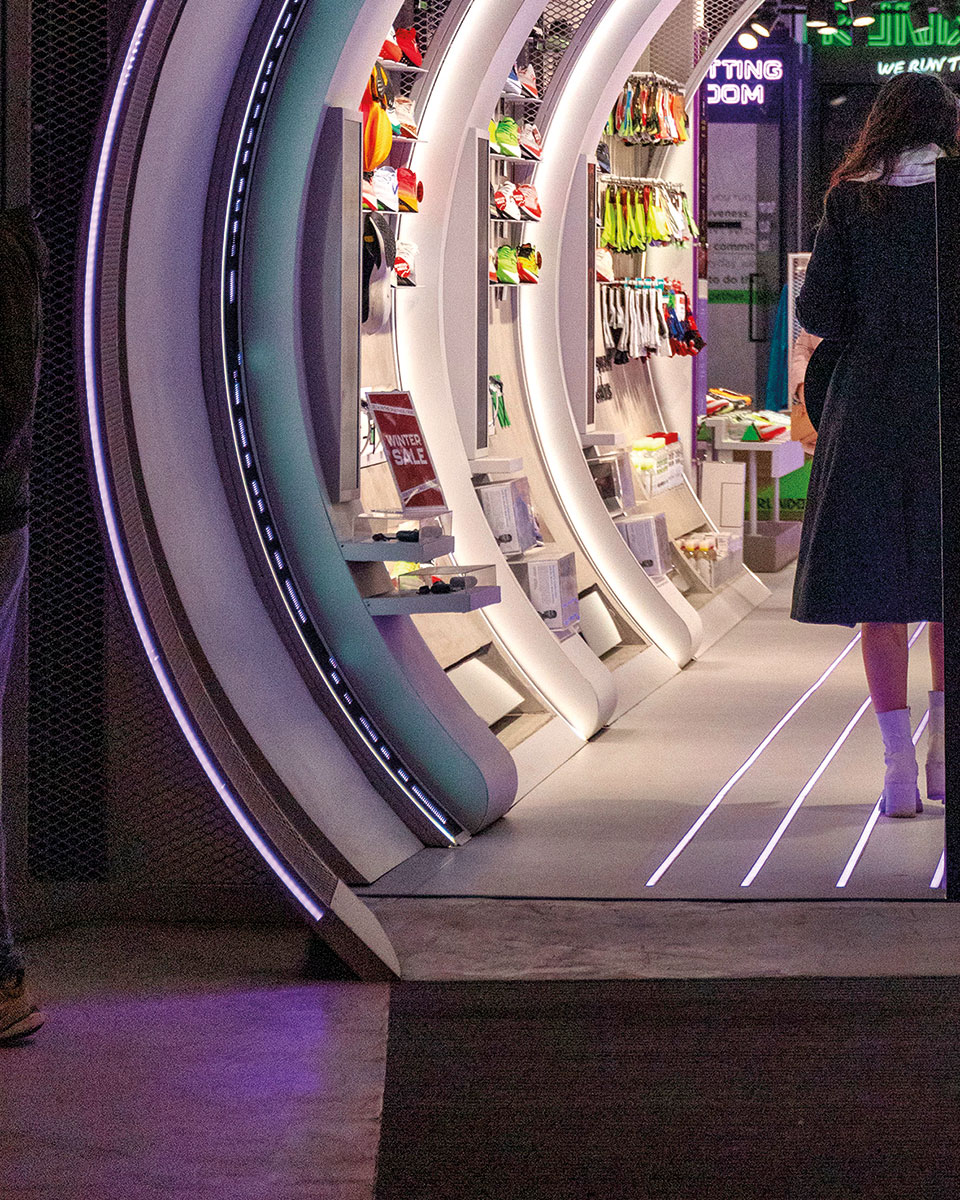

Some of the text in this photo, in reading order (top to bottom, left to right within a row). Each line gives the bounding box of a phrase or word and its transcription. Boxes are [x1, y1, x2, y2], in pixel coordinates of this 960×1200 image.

[877, 60, 906, 75] WE
[907, 56, 948, 74] RUN
[385, 433, 422, 448] WINTER
[391, 448, 428, 466] SALE
